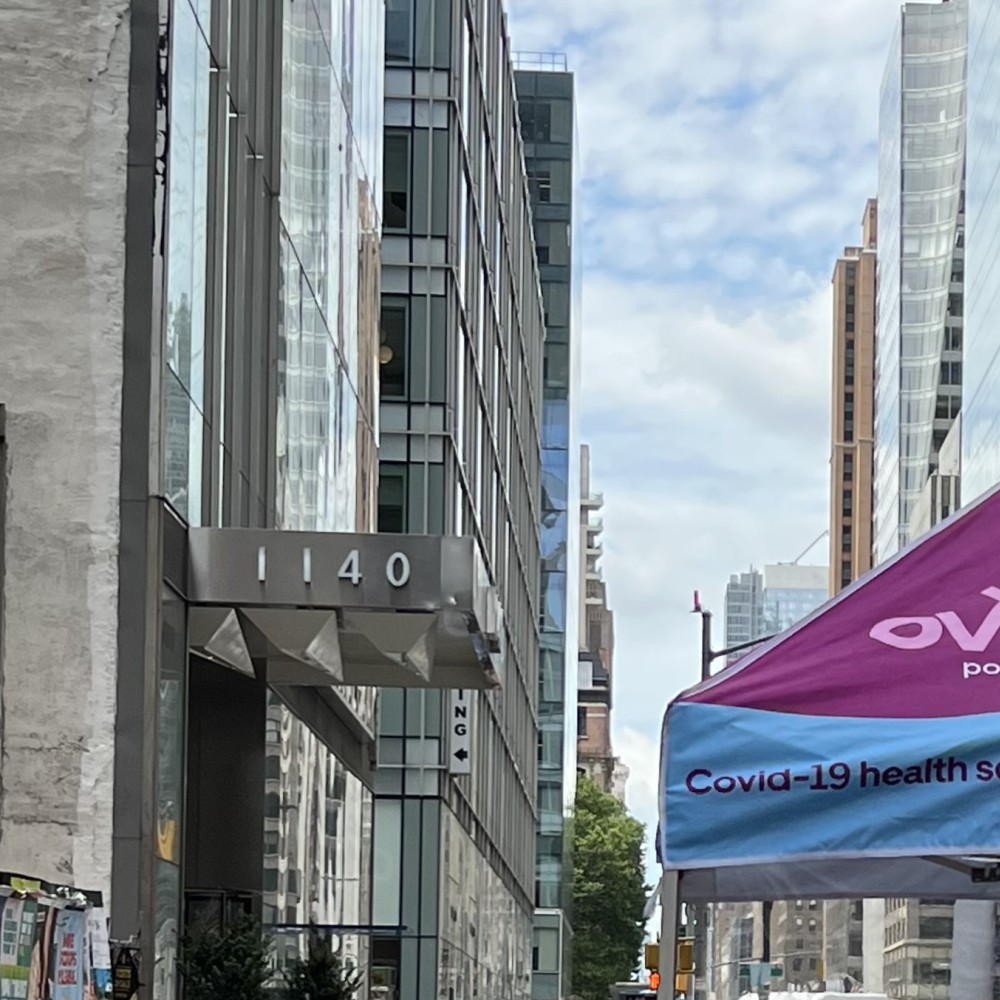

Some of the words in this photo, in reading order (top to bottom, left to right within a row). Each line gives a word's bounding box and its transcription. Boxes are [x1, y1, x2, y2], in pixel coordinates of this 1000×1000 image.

[257, 546, 411, 587] 1140
[685, 761, 851, 796] Covid-19
[859, 756, 968, 788] health
